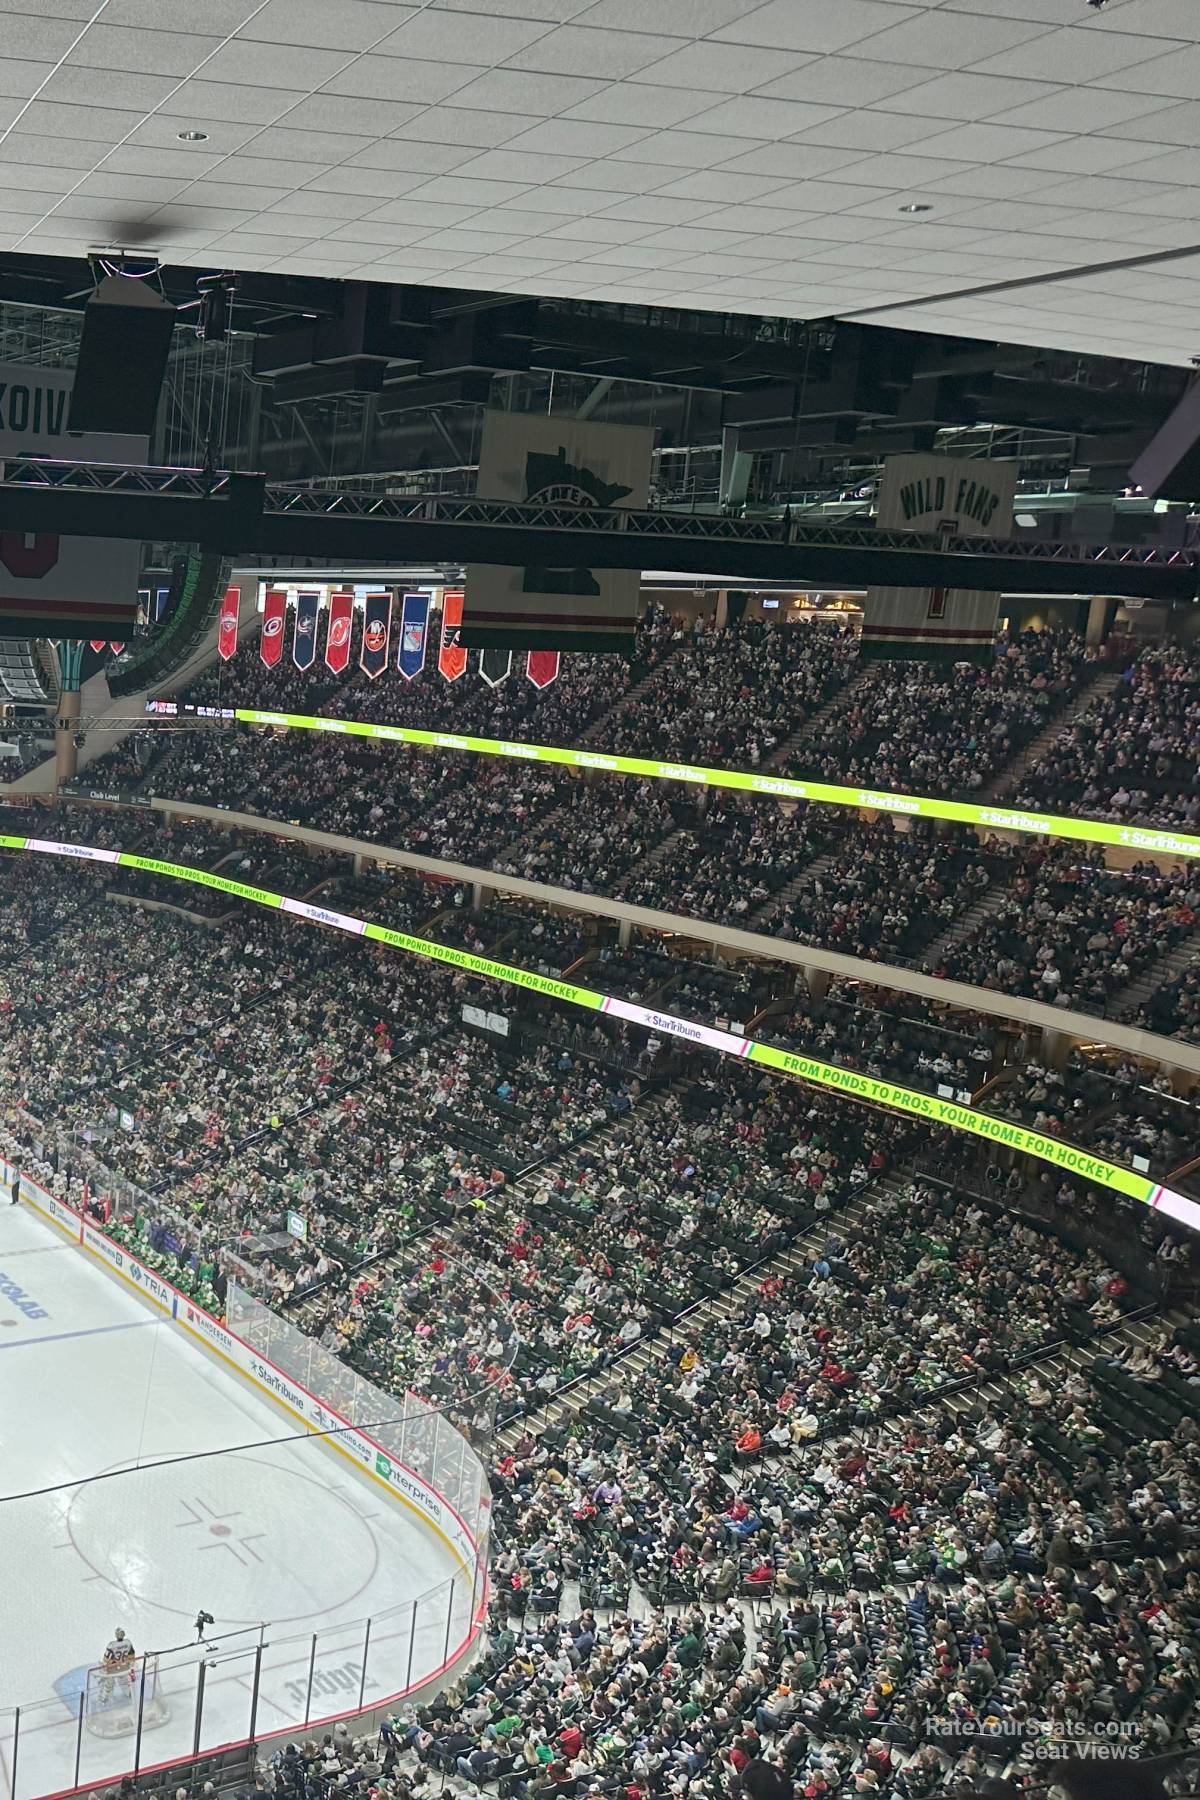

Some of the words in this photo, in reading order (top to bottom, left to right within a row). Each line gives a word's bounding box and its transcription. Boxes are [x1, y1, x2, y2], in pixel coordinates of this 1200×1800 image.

[900, 476, 946, 520] WILD
[954, 478, 1000, 527] FANS
[990, 812, 1050, 831] StarTribune
[384, 932, 405, 945] FROM
[406, 938, 432, 954] PONDS
[434, 946, 444, 957] TO
[445, 952, 467, 965] PROS,
[469, 958, 492, 974] YOUR
[494, 966, 520, 982] HOME
[521, 974, 538, 988] FOR
[540, 980, 578, 1000] HOCKEY
[652, 1015, 701, 1038] StarTribune
[784, 1056, 820, 1078] FROM
[822, 1068, 868, 1092] PONDS
[871, 1083, 890, 1099] TO
[892, 1090, 933, 1115] PROS,
[938, 1104, 976, 1128] YOUR
[979, 1119, 1022, 1146] HOME
[1025, 1136, 1054, 1157] FOR
[1058, 1148, 1116, 1182] HOCKEY
[143, 1273, 168, 1302] TRIA
[201, 1320, 233, 1347] ANDERSEN
[258, 1366, 304, 1410] StarTribune
[380, 1462, 440, 1516] enterprise
